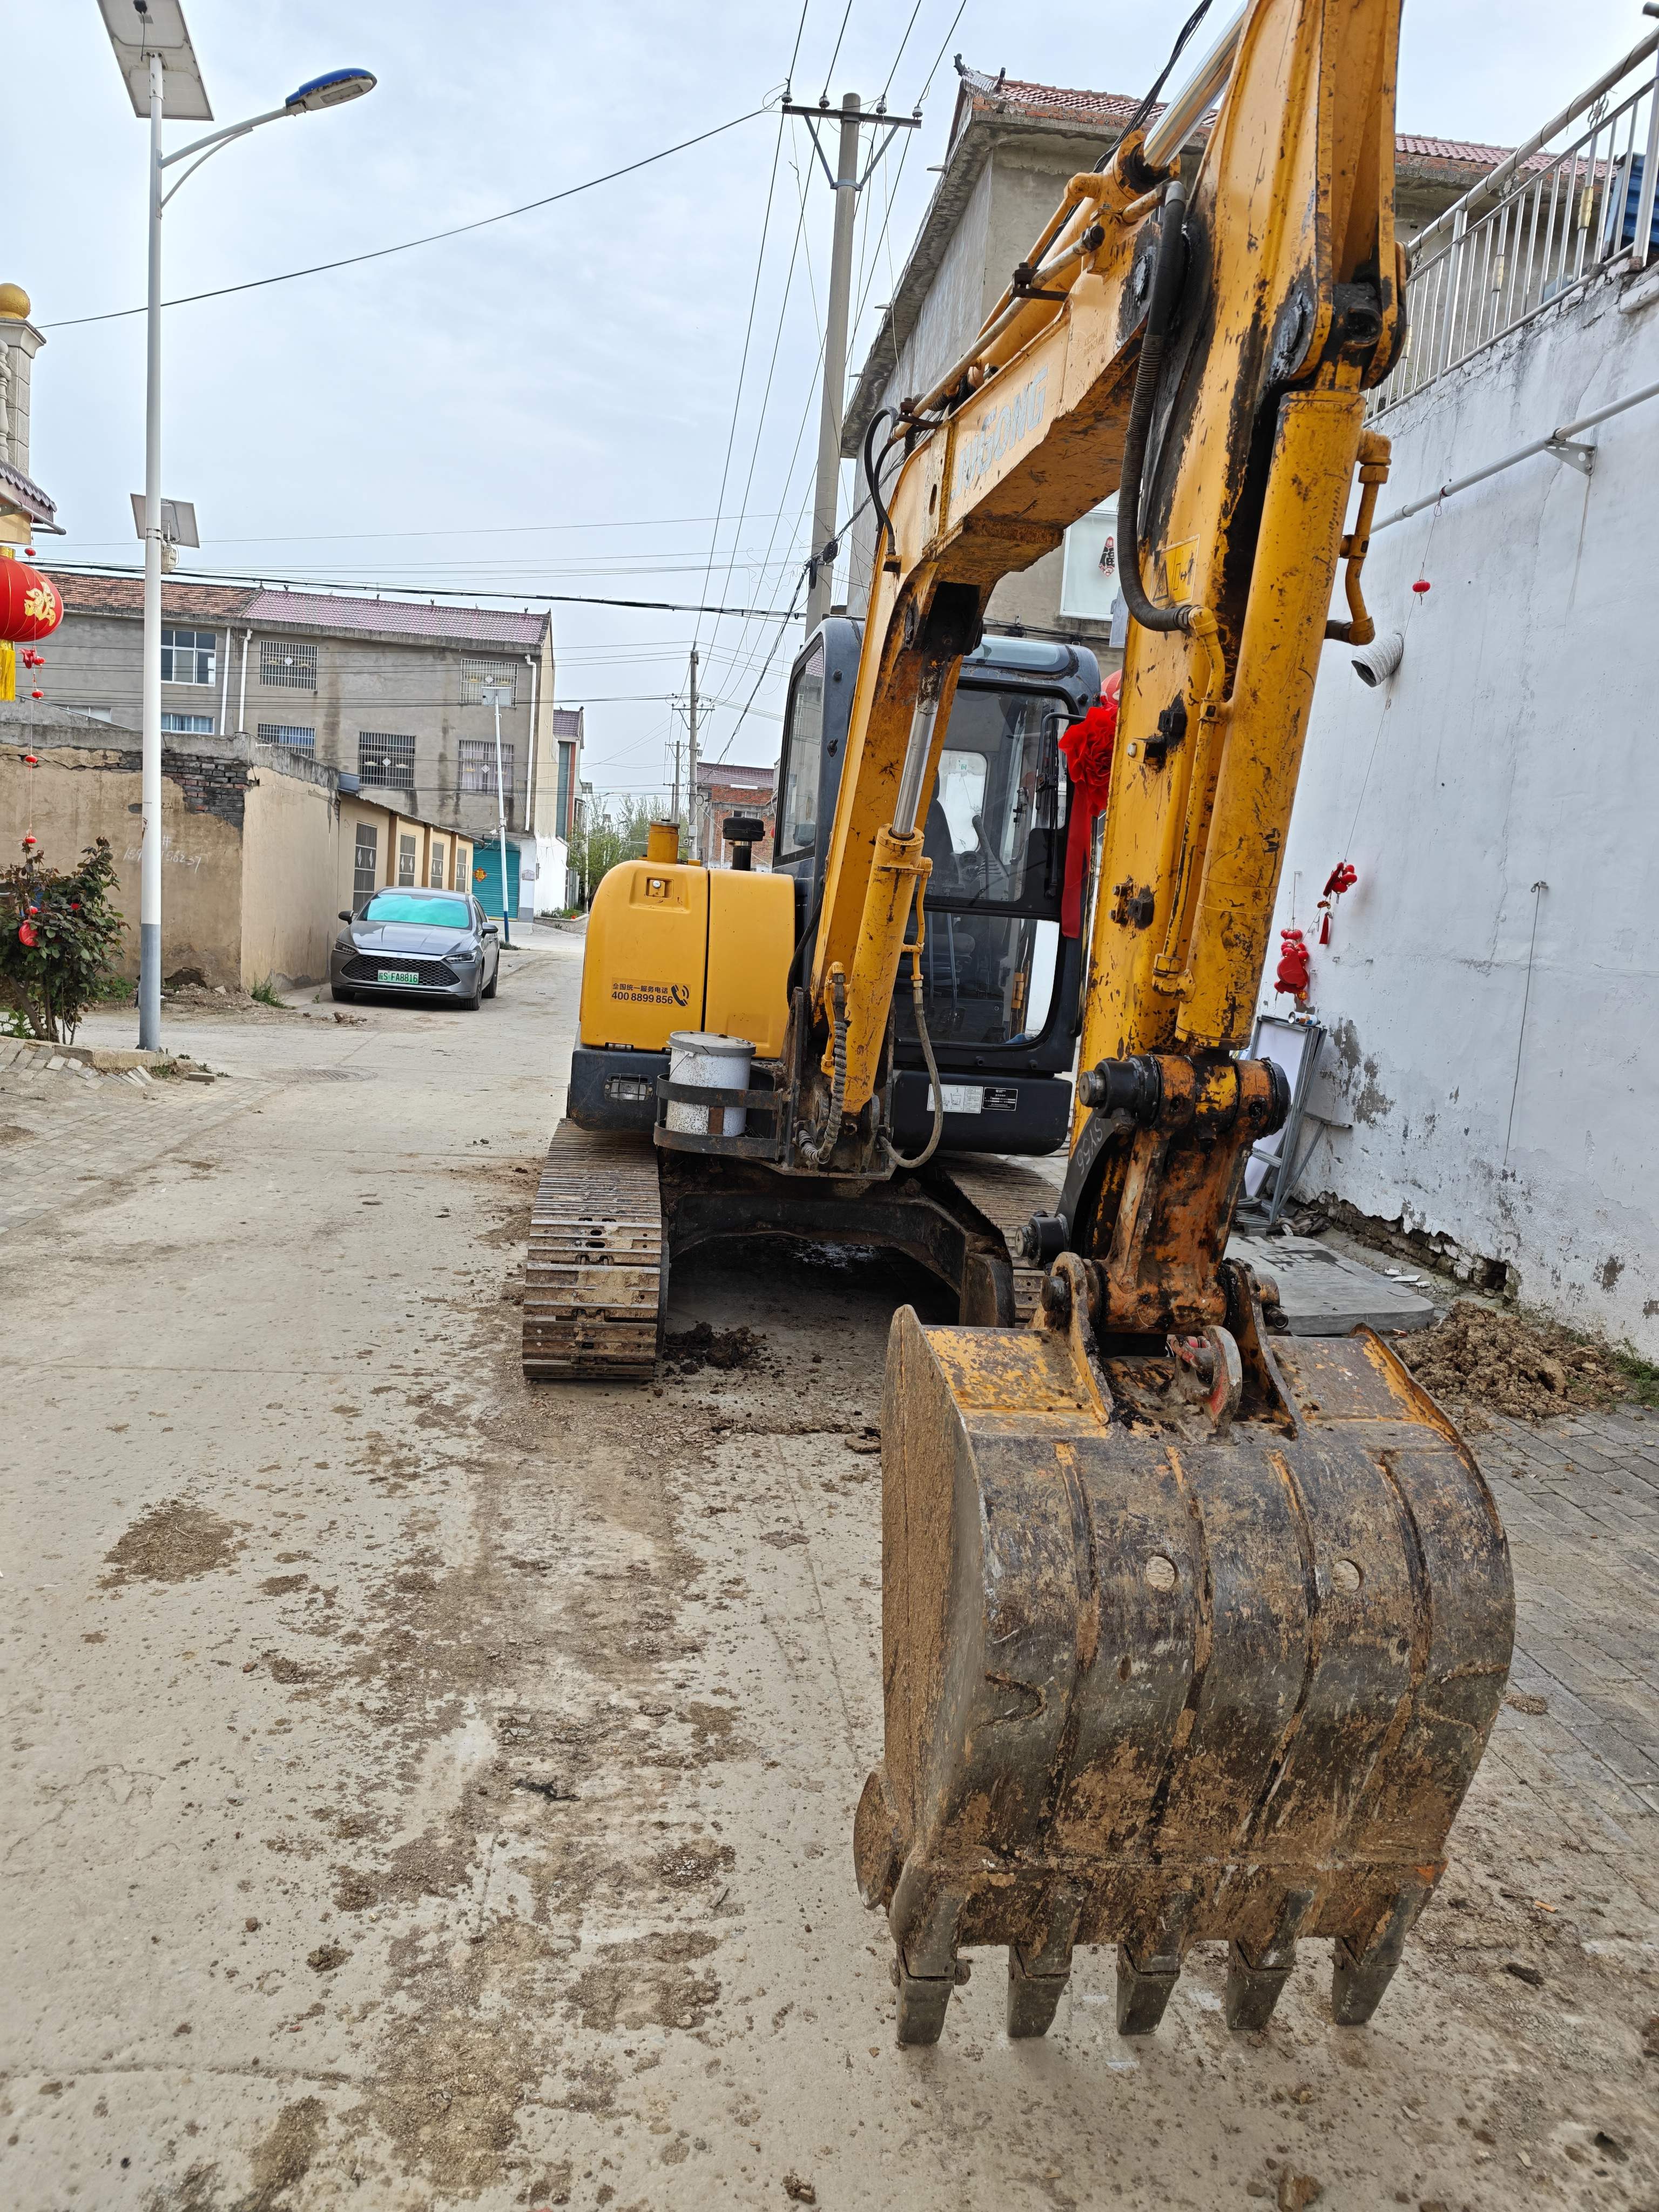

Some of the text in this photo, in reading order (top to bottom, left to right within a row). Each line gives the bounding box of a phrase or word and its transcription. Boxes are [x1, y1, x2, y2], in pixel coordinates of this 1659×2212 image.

[612, 983, 669, 994] 全国统一服务电话
[611, 991, 673, 1004] 400 8899 856
